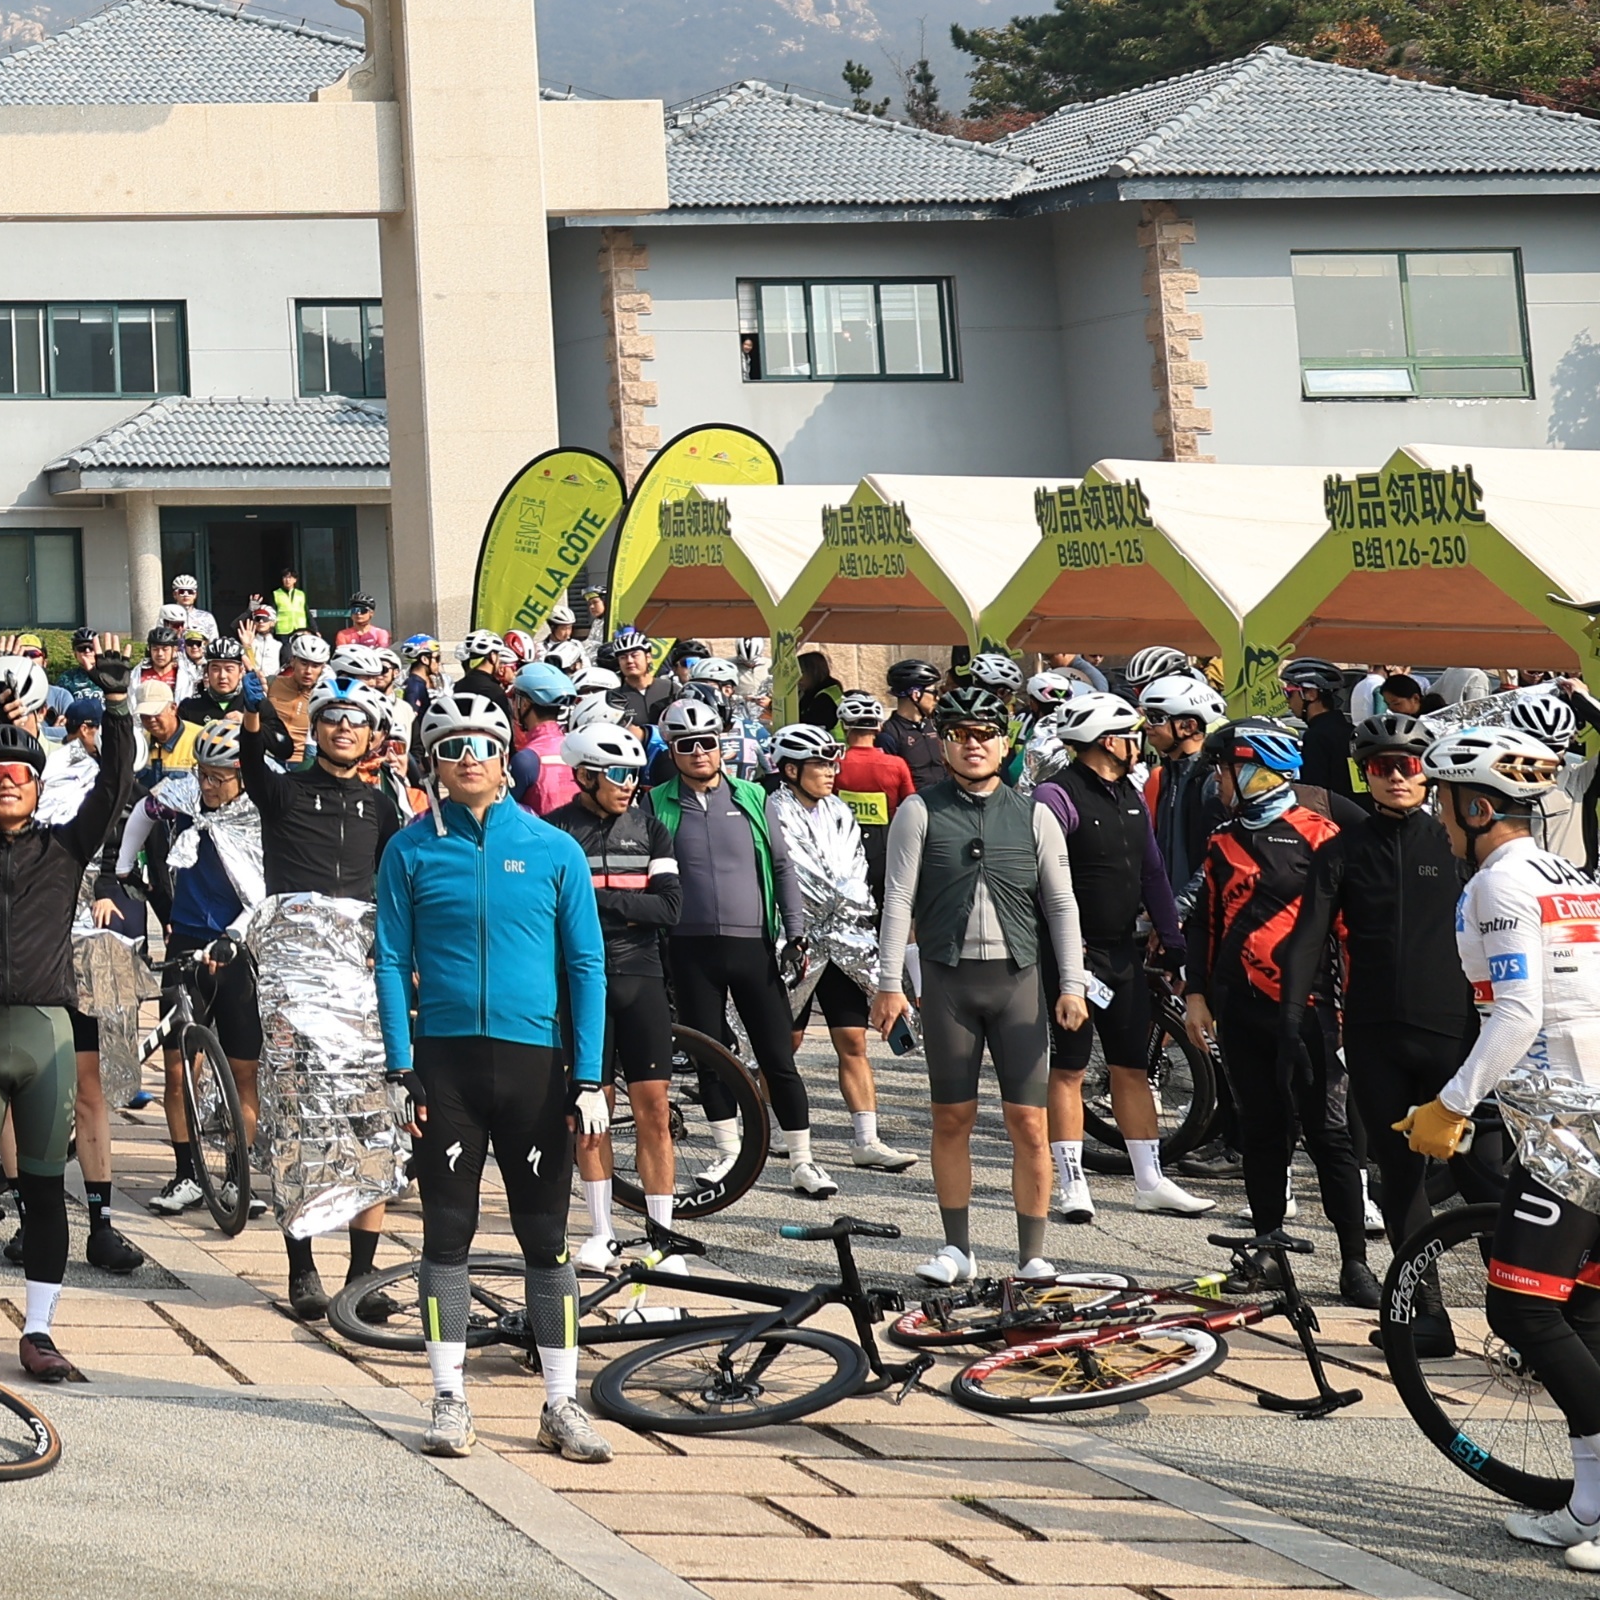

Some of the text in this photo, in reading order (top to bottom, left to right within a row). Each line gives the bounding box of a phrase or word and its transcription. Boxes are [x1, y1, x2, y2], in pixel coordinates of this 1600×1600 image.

[1033, 477, 1154, 537] 物品领取处
[1324, 464, 1486, 533] 物品领取处
[658, 496, 732, 538] 物品领取处
[821, 500, 915, 547] 物品领取处
[668, 543, 723, 565] A组001-125
[838, 552, 905, 577] A组126-250
[1056, 538, 1143, 567] B组001-125
[1351, 534, 1467, 568] B组126-250
[514, 506, 608, 631] DE LA CÔTE
[1438, 767, 1477, 777] RUDY
[503, 858, 526, 874] GRC
[1418, 864, 1439, 877] GRC
[1495, 1268, 1541, 1288] Emirates
